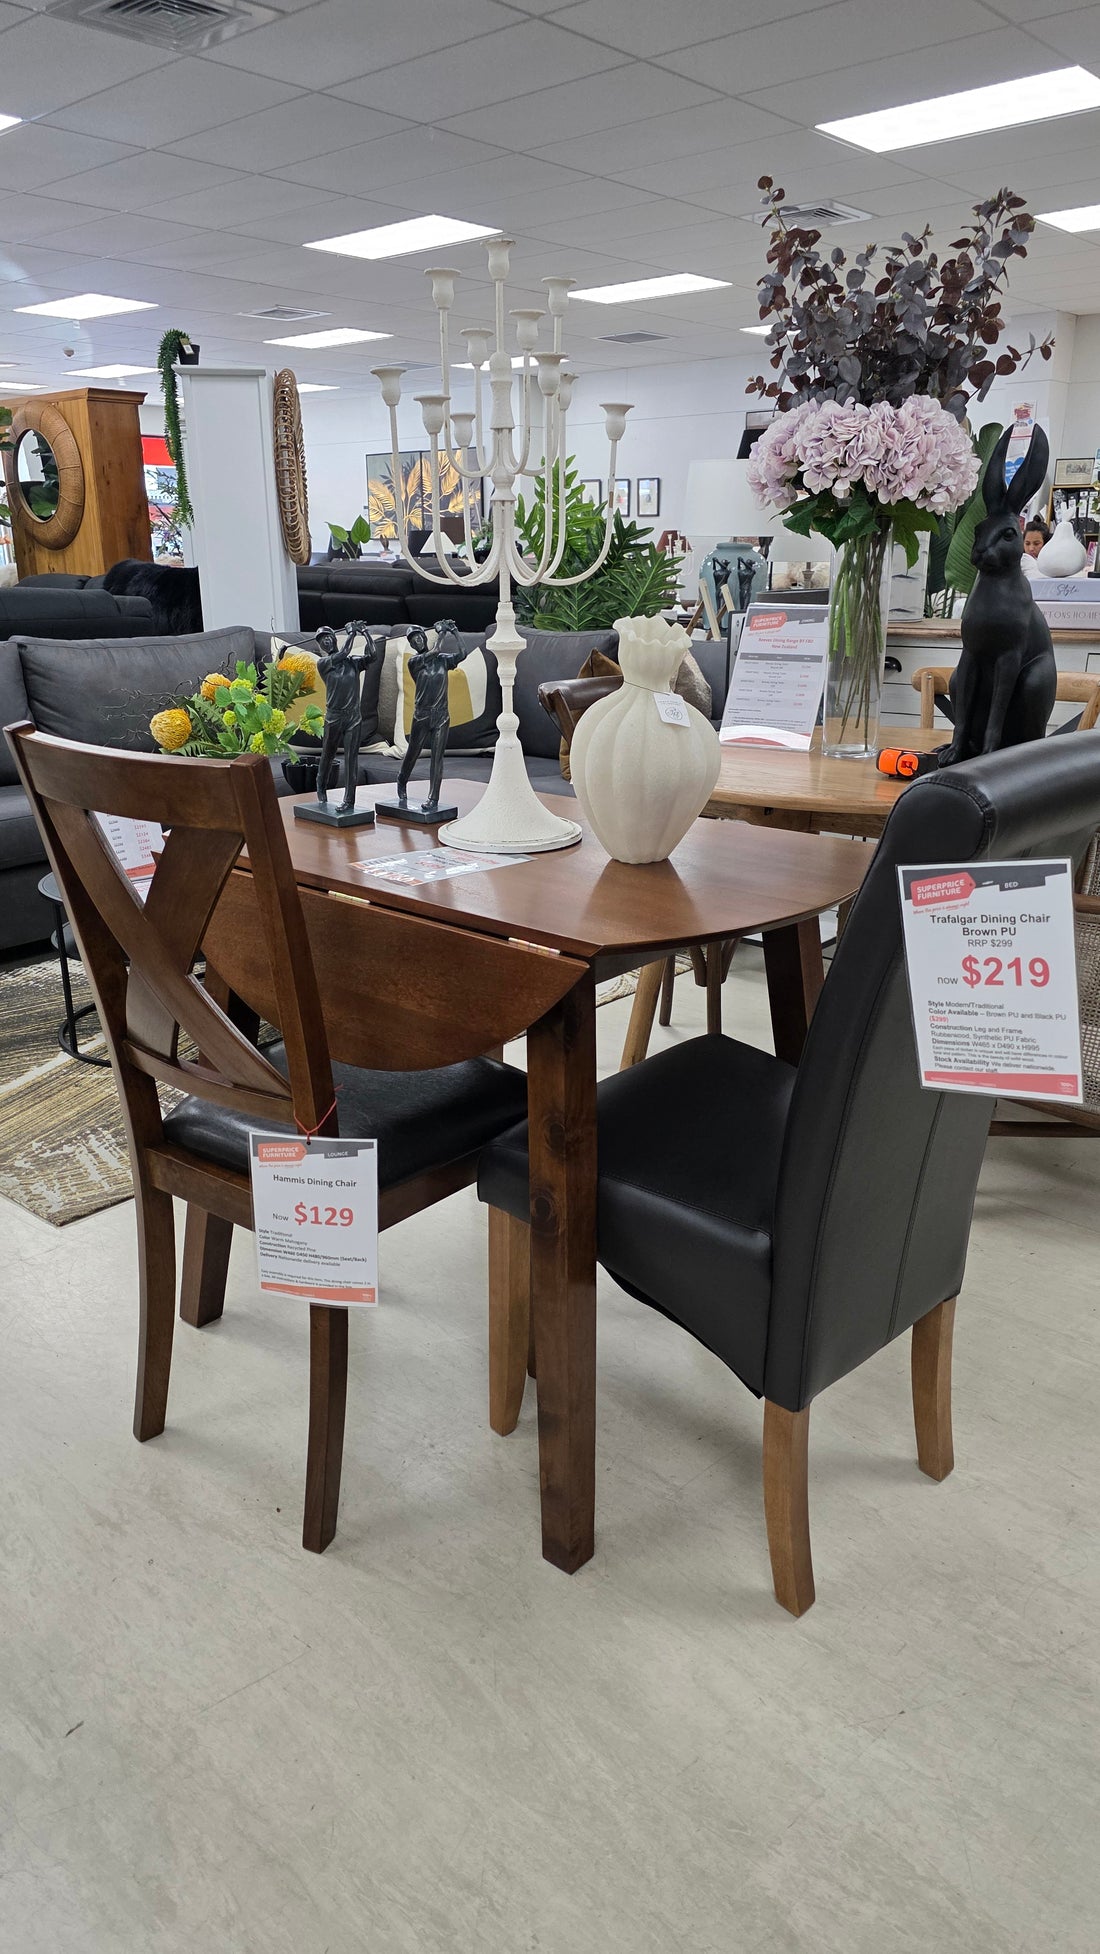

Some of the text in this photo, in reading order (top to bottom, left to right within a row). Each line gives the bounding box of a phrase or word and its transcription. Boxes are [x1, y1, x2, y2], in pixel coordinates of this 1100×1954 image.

[1057, 584, 1078, 596] Style
[917, 879, 964, 892] SUPERPRICE
[918, 888, 960, 900] FURNITURE
[930, 914, 1050, 925] Trafalgar Dining Chair
[962, 927, 1016, 936] Brown PU
[968, 939, 1012, 947] RRP $299
[962, 955, 1049, 988] $219
[946, 1001, 1004, 1009] Modern/Traditional
[930, 1023, 972, 1031] Construction
[932, 1038, 970, 1046] Dimensions
[954, 1058, 989, 1066] Availability
[273, 1174, 357, 1188] Hammis Dining Chair
[273, 1202, 353, 1226] Now $129
